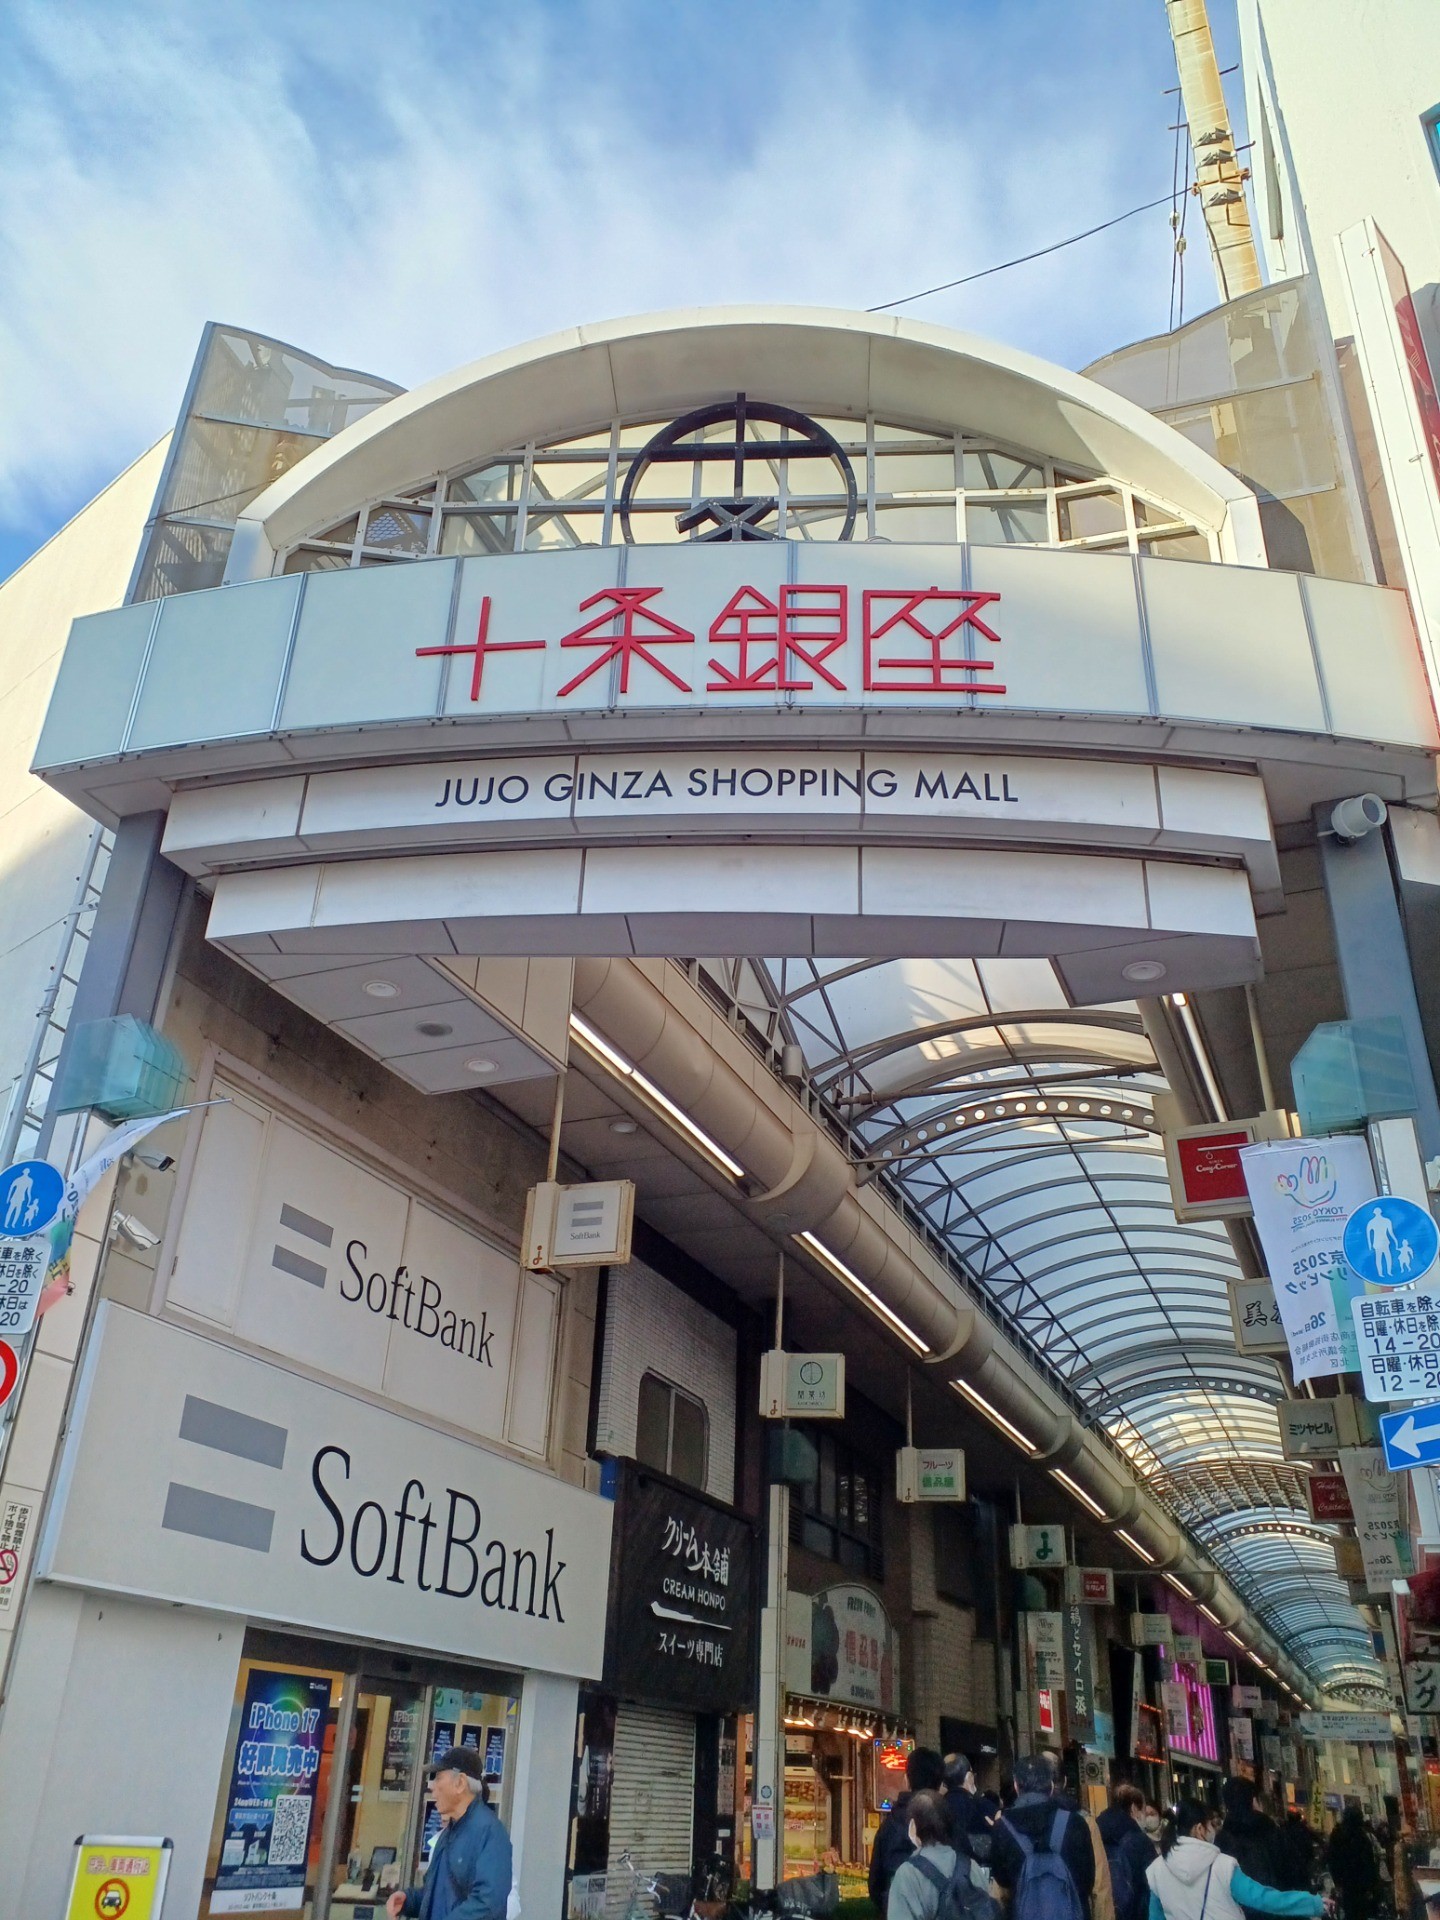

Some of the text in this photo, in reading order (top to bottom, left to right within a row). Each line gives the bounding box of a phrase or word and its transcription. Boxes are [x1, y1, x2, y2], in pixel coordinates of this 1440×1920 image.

[415, 584, 1007, 701] 十条銀座
[435, 767, 1019, 808] JUJO GINZA SHOPPING MALL
[570, 1231, 601, 1240] SoftBank
[0, 1246, 43, 1261] 車を除く
[340, 1239, 494, 1368] SoftBank
[1289, 1423, 1333, 1436] ミツヤビル
[922, 1460, 954, 1470] フルーツ
[300, 1445, 567, 1623] SoftBank
[661, 1515, 731, 1586] クリーム本舗
[663, 1577, 726, 1611] CREAM HONPO
[659, 1631, 724, 1668] スイーツ専門店
[249, 1702, 320, 1734] iPhone 17
